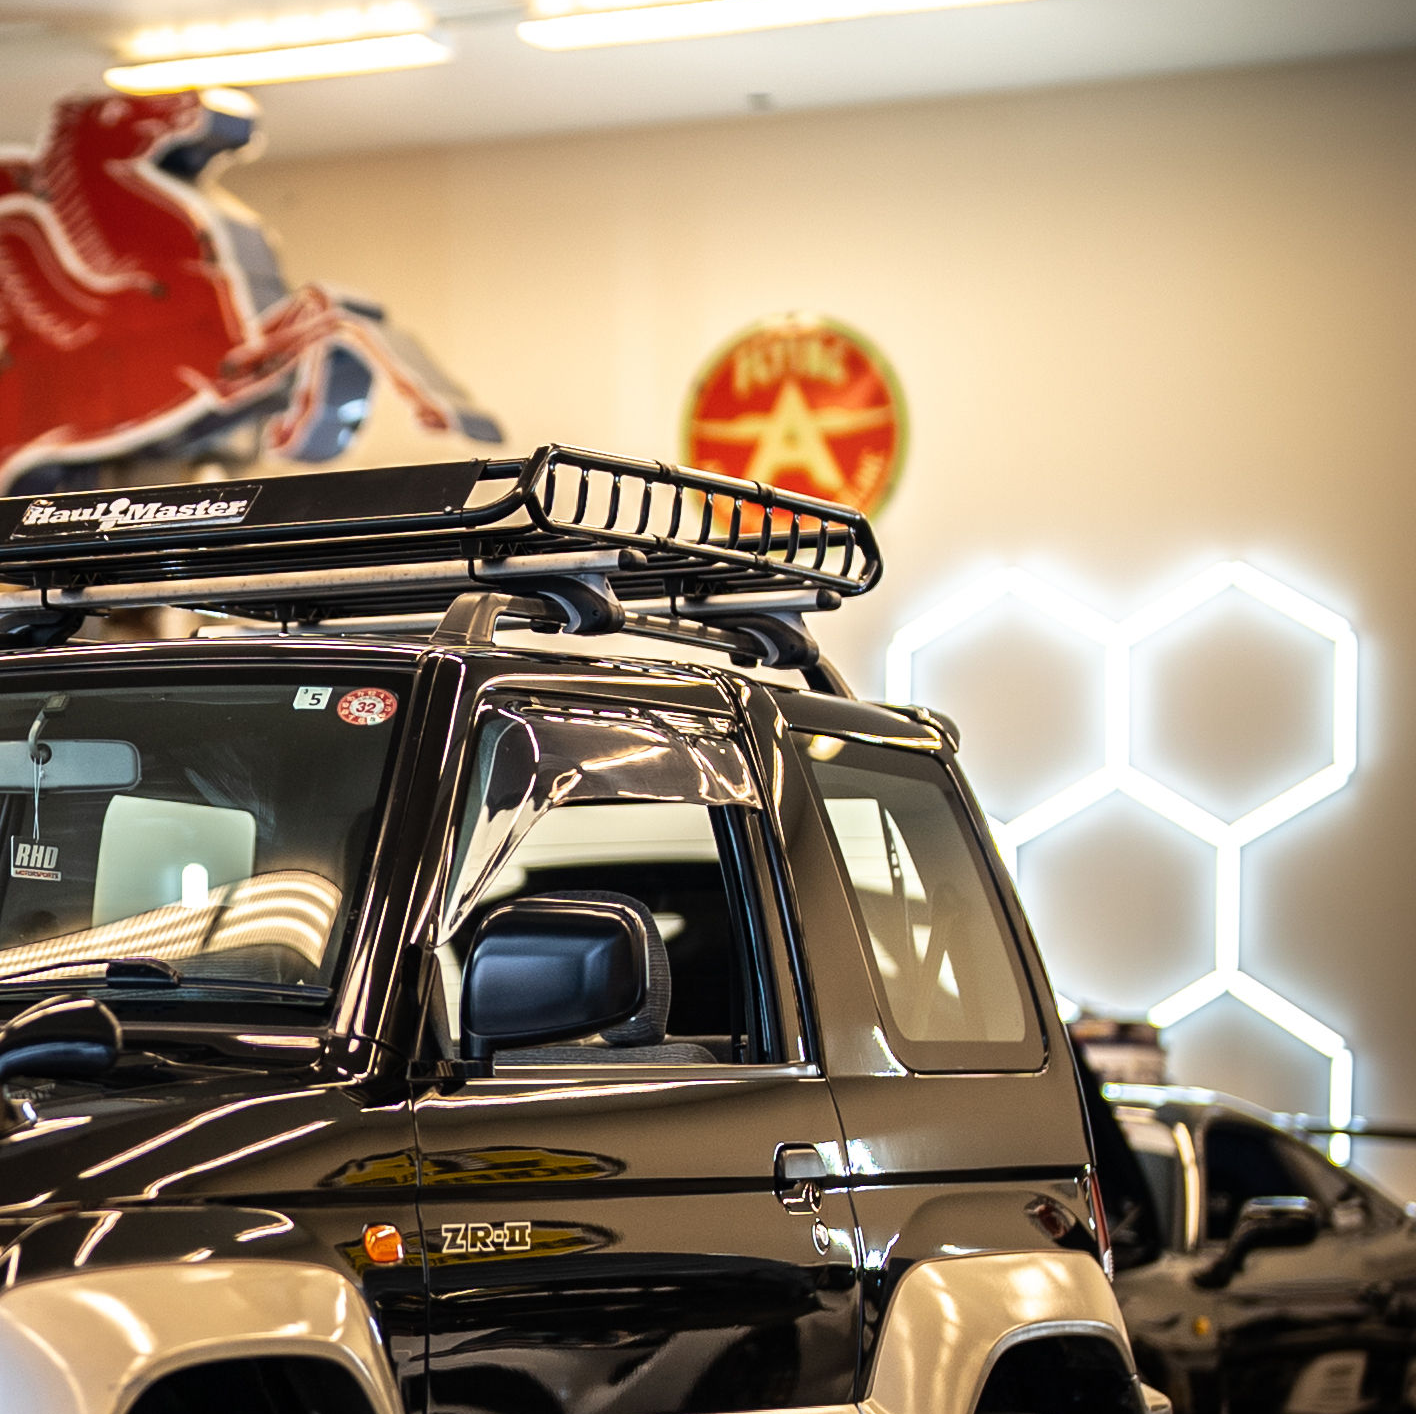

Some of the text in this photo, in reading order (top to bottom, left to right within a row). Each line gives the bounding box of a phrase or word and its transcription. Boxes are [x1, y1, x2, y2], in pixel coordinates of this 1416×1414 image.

[24, 499, 248, 525] Haul Master
[308, 692, 323, 707] 5
[355, 701, 377, 714] 32
[14, 842, 59, 869] RHD
